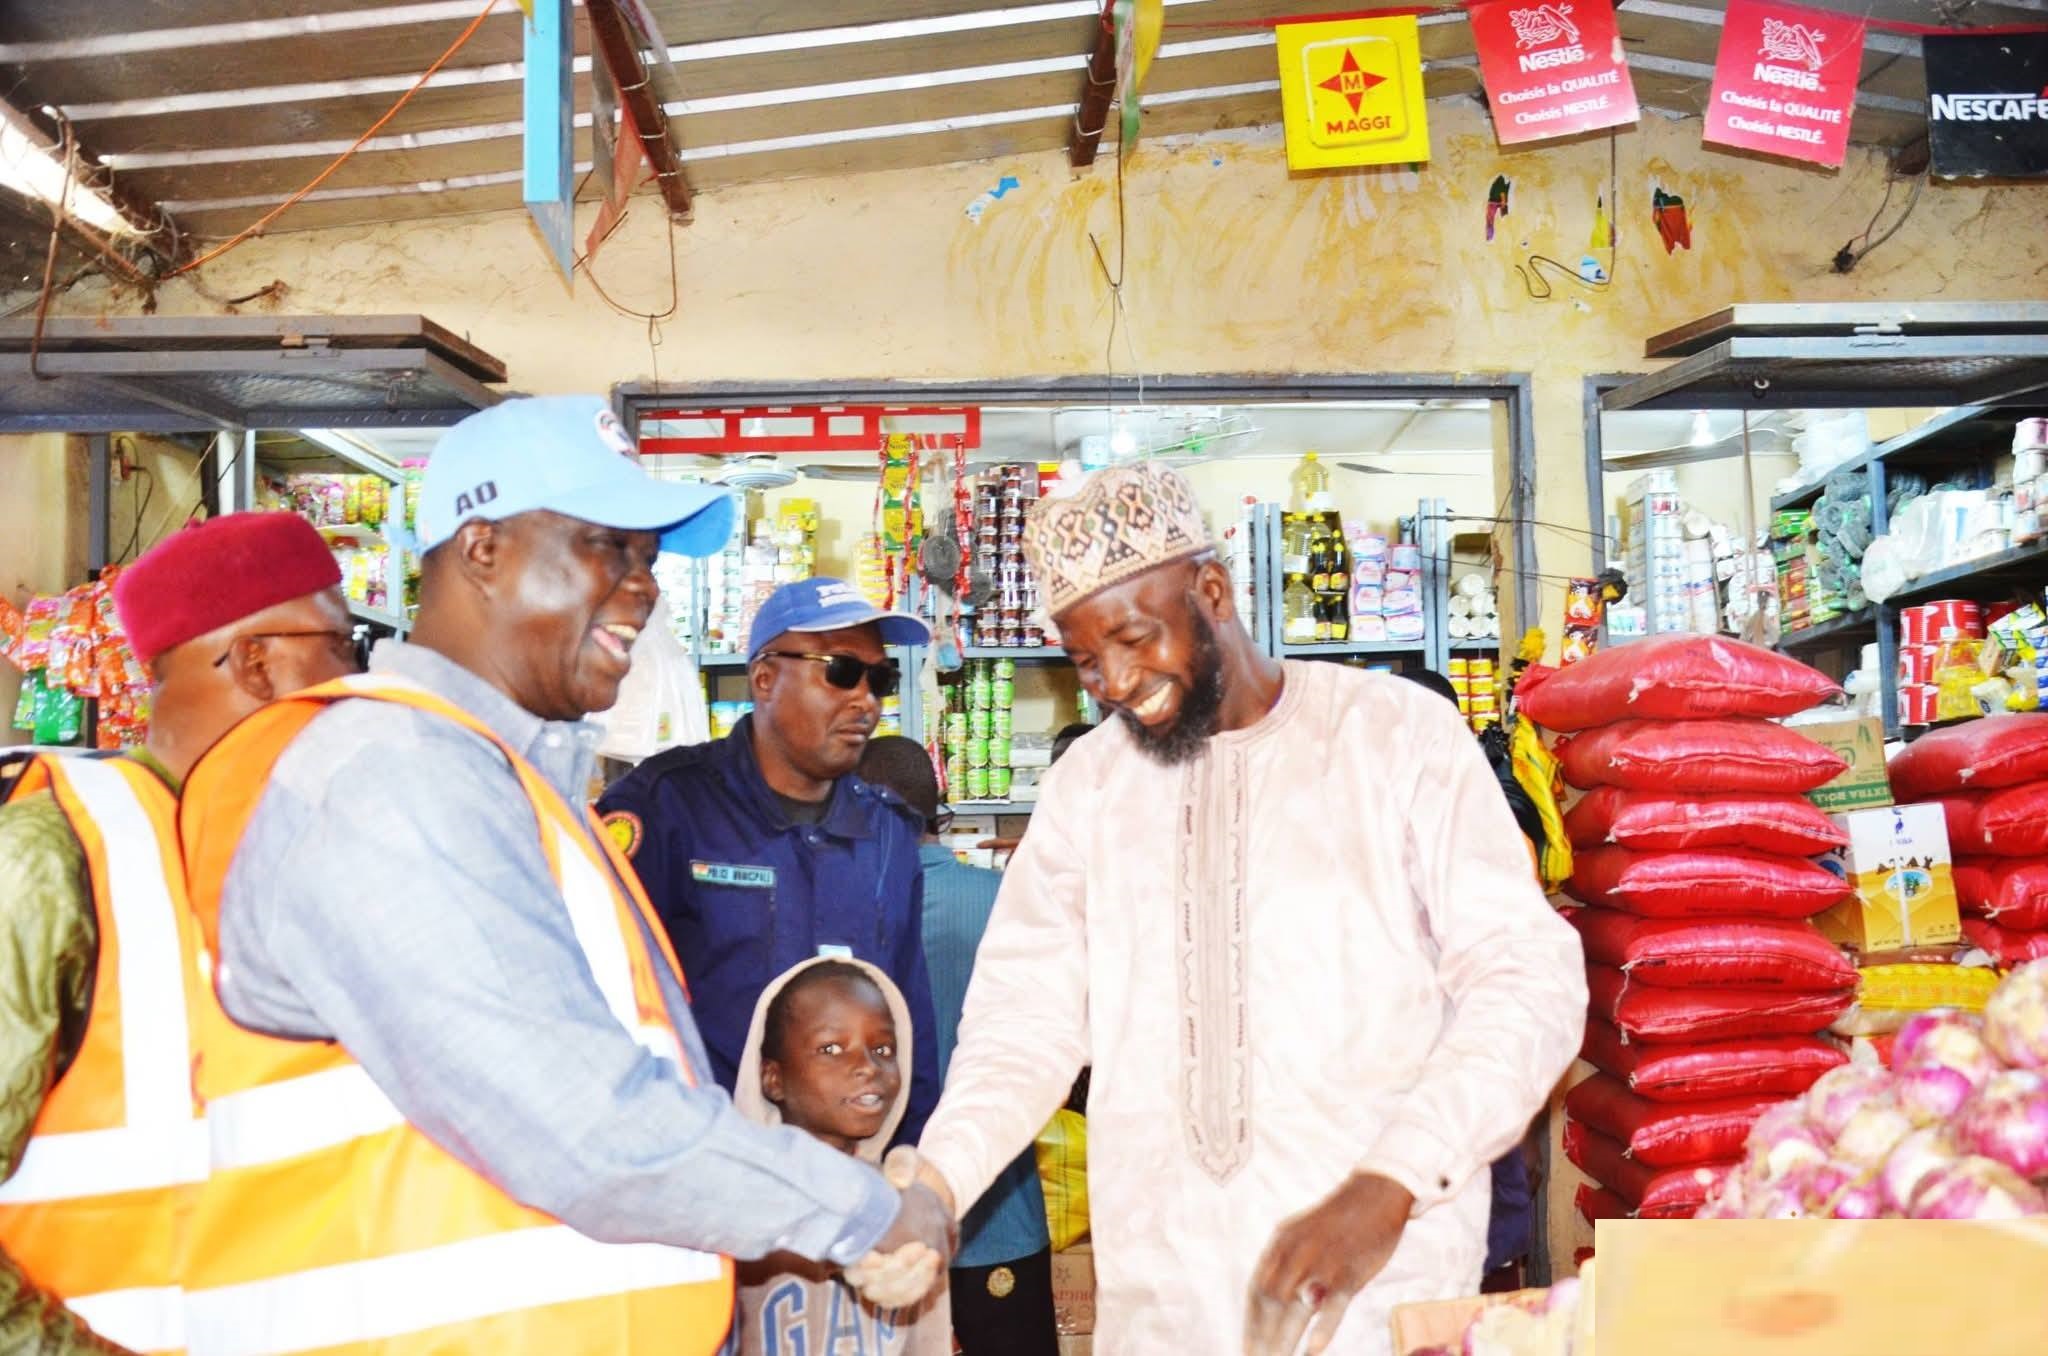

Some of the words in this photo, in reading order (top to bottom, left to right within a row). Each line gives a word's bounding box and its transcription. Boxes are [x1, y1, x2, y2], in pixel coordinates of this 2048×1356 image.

[1499, 86, 1546, 104] Choisis
[1547, 83, 1561, 95] la
[1562, 70, 1620, 93] QUALITÉ
[1515, 106, 1562, 124] Choisis
[1721, 90, 1767, 110] Choisis
[1769, 99, 1782, 113] la
[1784, 102, 1842, 124] QUALITÉ
[1326, 116, 1392, 135] MAGGI
[1728, 116, 1775, 135] Choisis
